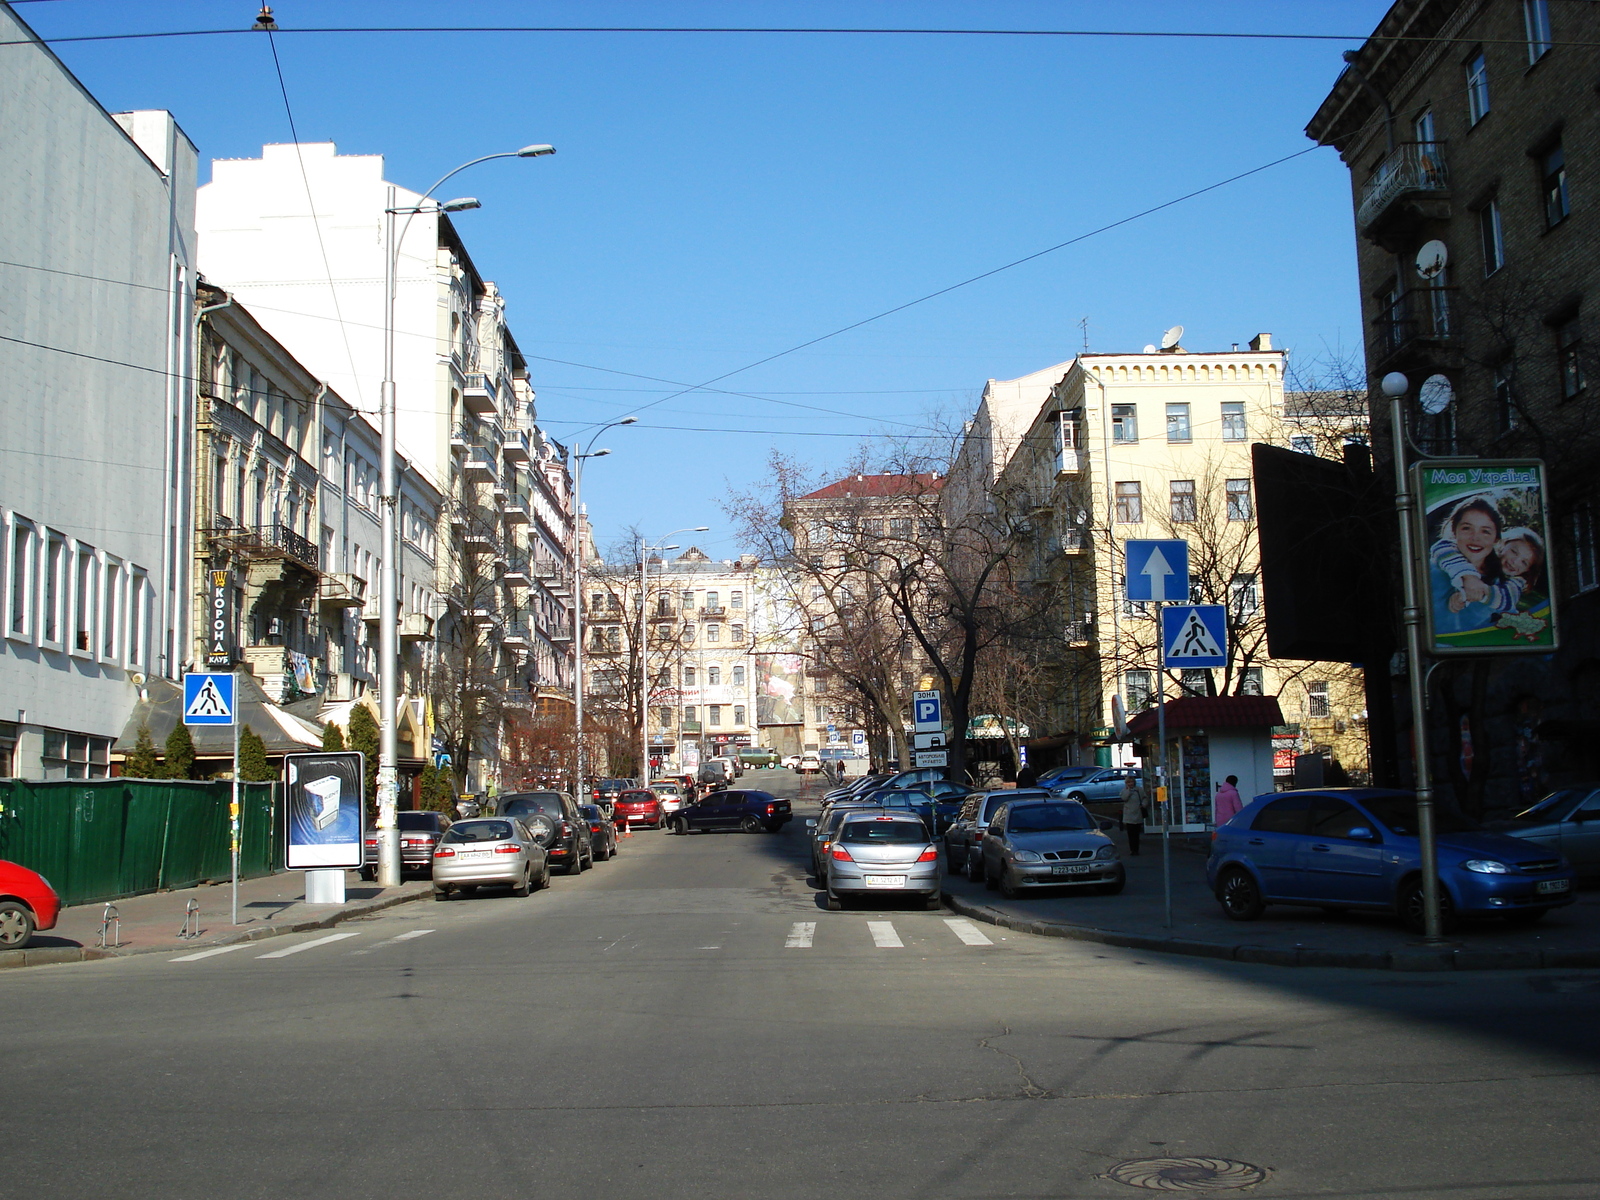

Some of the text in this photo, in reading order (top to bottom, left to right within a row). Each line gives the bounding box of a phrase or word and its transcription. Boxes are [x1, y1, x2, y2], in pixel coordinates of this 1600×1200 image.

[1431, 468, 1537, 486] Моя Україна!
[214, 588, 225, 652] КОРОНА
[920, 703, 935, 720] P
